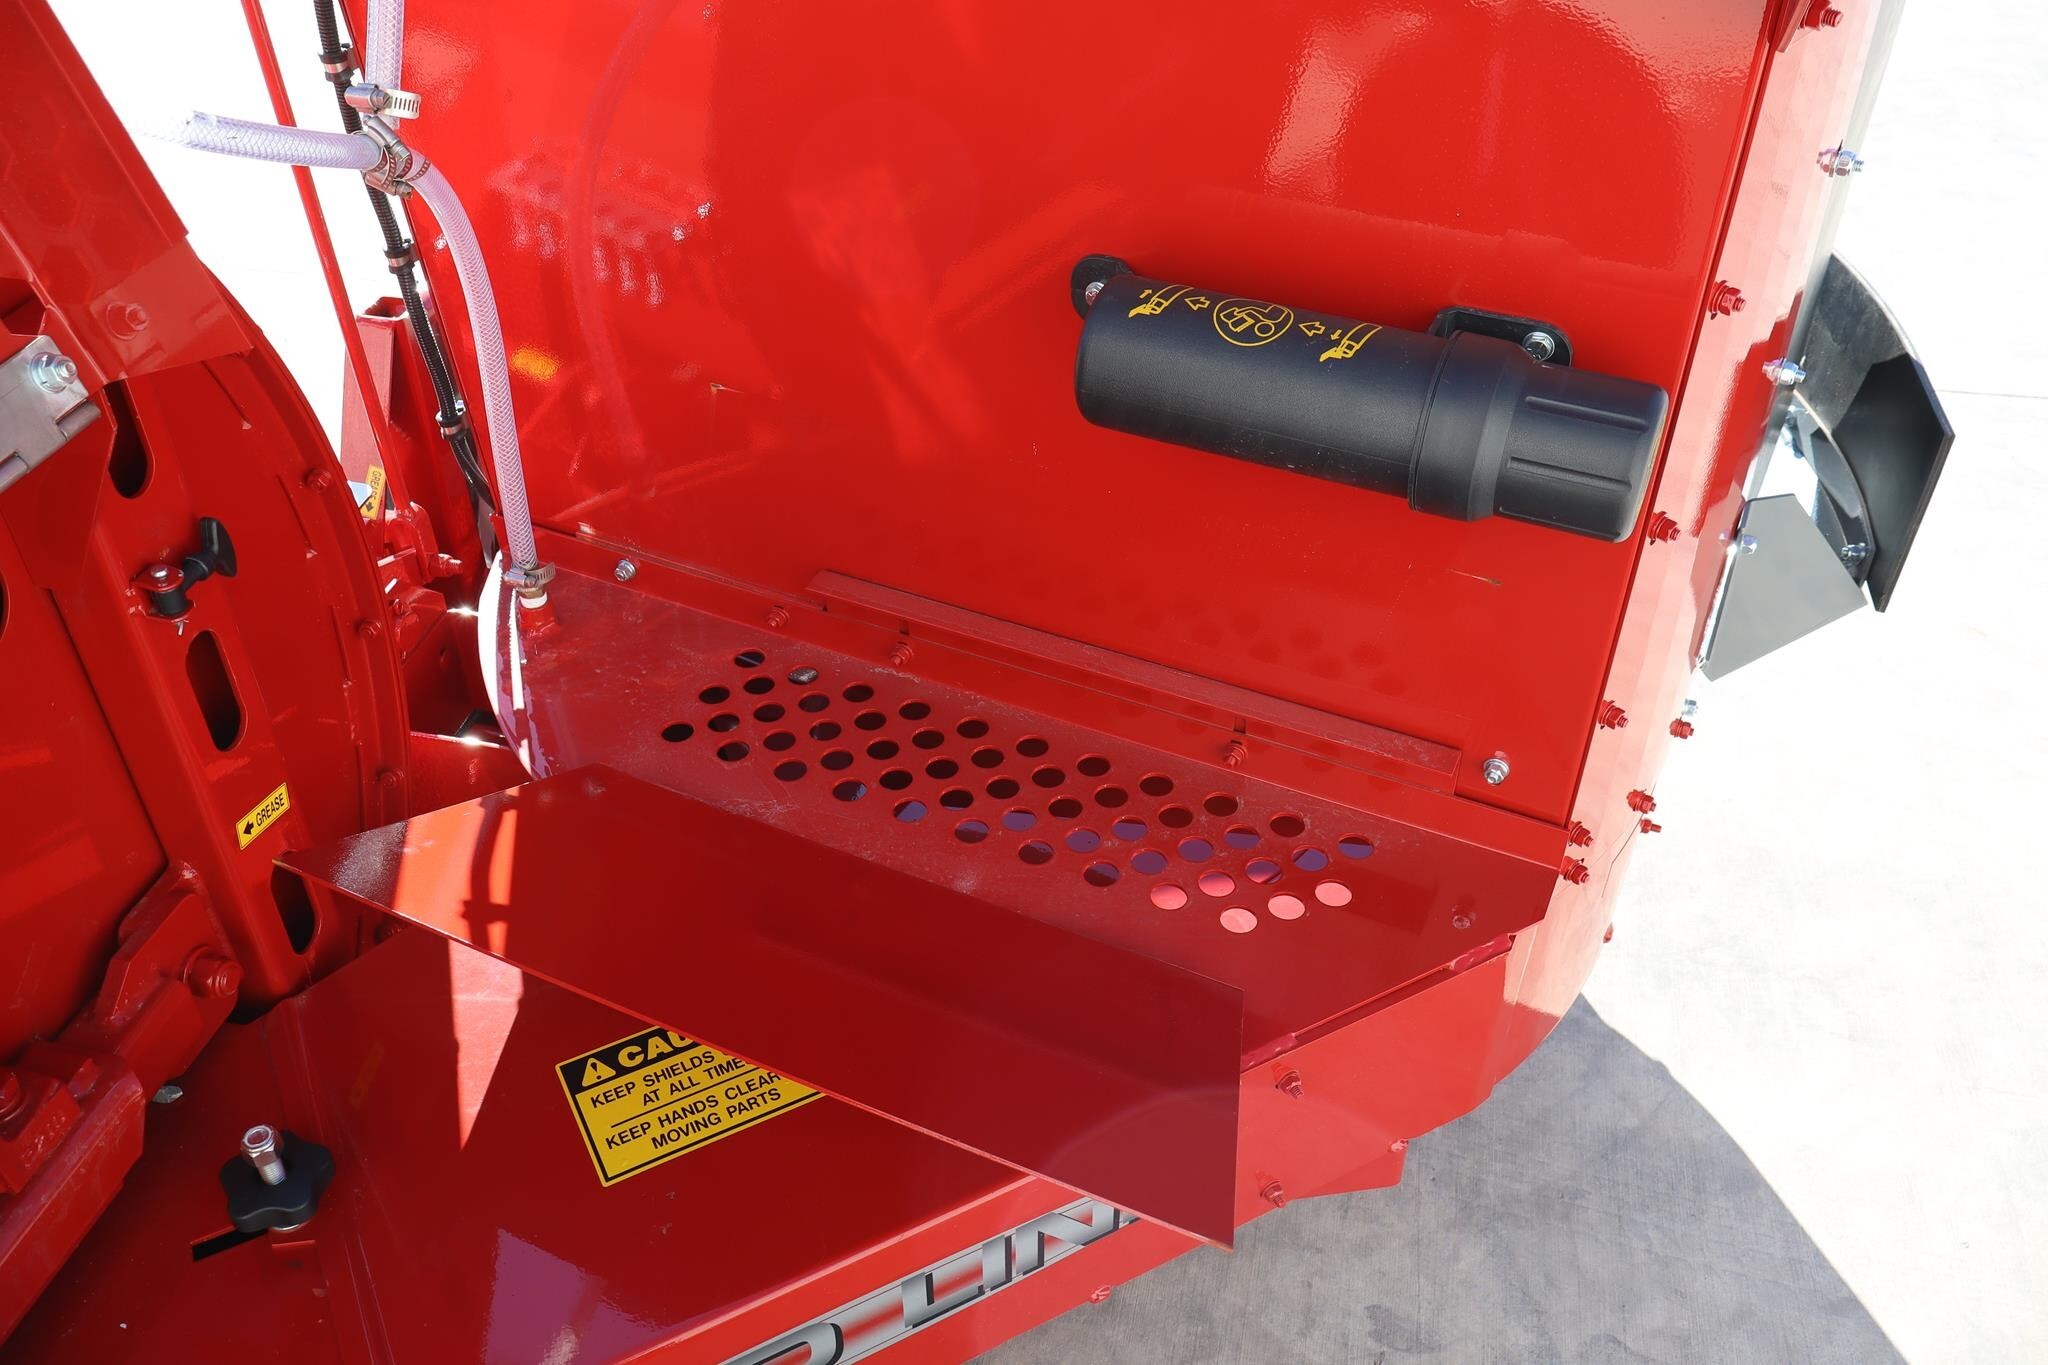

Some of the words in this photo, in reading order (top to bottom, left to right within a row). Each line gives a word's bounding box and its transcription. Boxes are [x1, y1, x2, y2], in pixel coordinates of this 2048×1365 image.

[255, 793, 285, 827] GREASE
[617, 1031, 694, 1068] CAU
[590, 1082, 636, 1109] KEEP
[643, 1051, 715, 1087] SHIELDS
[642, 1089, 662, 1107] AT
[669, 1076, 700, 1096] ALL
[702, 1057, 750, 1080] TIME
[605, 1121, 651, 1150] KEEP
[657, 1095, 720, 1128] HANDS
[724, 1071, 782, 1101] CLEAR
[650, 1113, 722, 1150] MOVING
[726, 1087, 782, 1119] PARTS
[901, 1199, 1140, 1329] LIN
